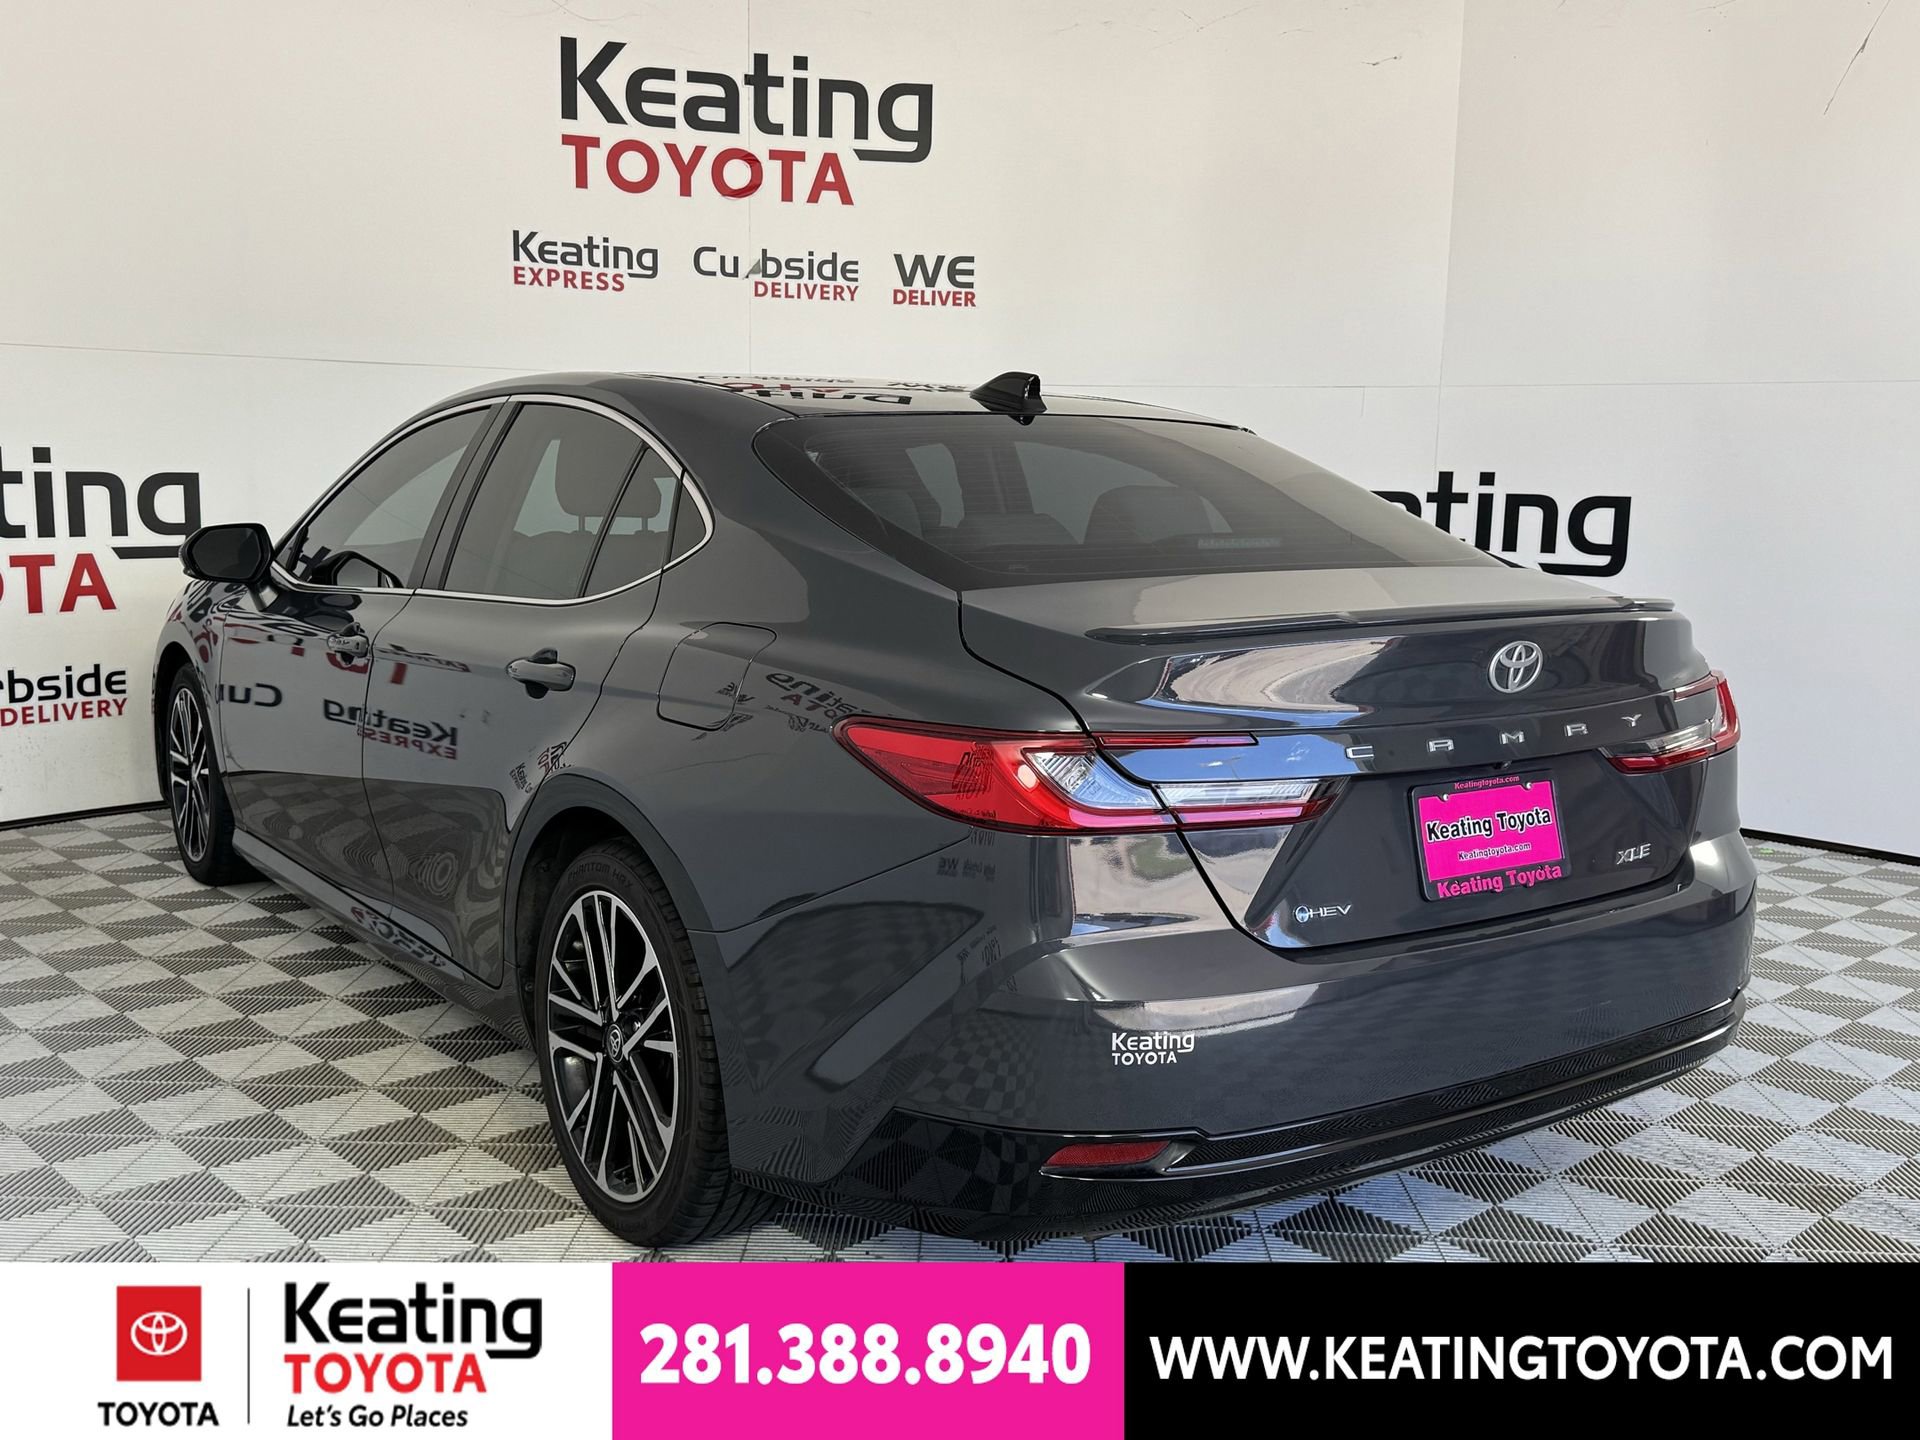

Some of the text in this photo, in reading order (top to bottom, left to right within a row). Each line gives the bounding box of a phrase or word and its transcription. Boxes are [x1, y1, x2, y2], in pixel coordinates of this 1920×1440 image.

[560, 36, 934, 163] Keating
[561, 134, 854, 206] TOYOTA
[512, 230, 659, 279] Keating
[693, 247, 859, 282] Cubside
[893, 253, 975, 289] WE
[513, 266, 625, 292] EXPRESS
[753, 281, 859, 302] DELIVERY
[892, 289, 976, 307] DELIVER
[0, 552, 117, 615] TA
[0, 663, 127, 704] bside
[0, 698, 128, 727] DELIVERY
[1346, 714, 1642, 760] CAMRY
[1427, 808, 1552, 842] Keating Toyota
[1458, 842, 1531, 861] Keatingtoyota.com
[1616, 843, 1652, 865] XLE
[1437, 864, 1562, 898] Keating Toyota
[1111, 1031, 1195, 1054] Keating
[1111, 1050, 1178, 1066] TOYOTA
